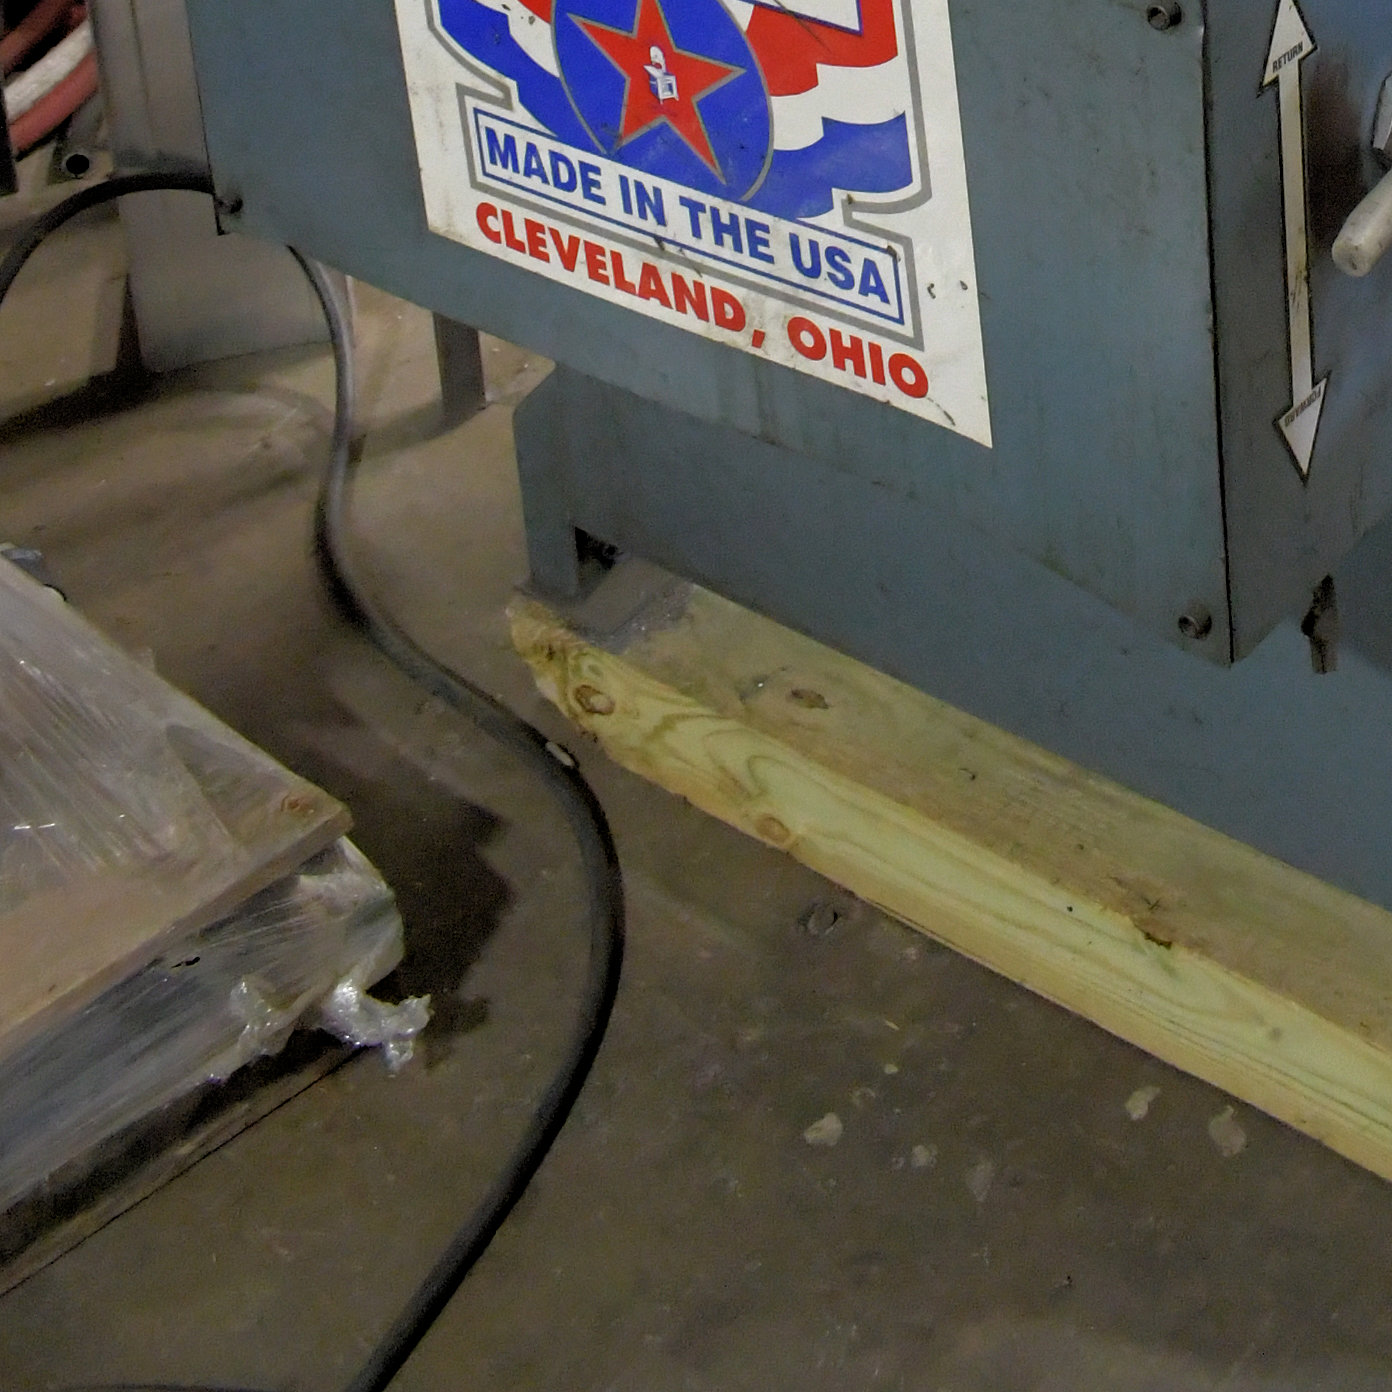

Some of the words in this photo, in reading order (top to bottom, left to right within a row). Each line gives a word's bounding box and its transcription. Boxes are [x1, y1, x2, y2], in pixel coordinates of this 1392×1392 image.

[1272, 40, 1303, 74] RETURN
[475, 201, 769, 350] CLEVELAND,
[786, 314, 930, 400] OHIO
[482, 125, 604, 208] MADE
[619, 172, 668, 228] IN
[677, 194, 776, 266] THE
[786, 233, 893, 306] USA
